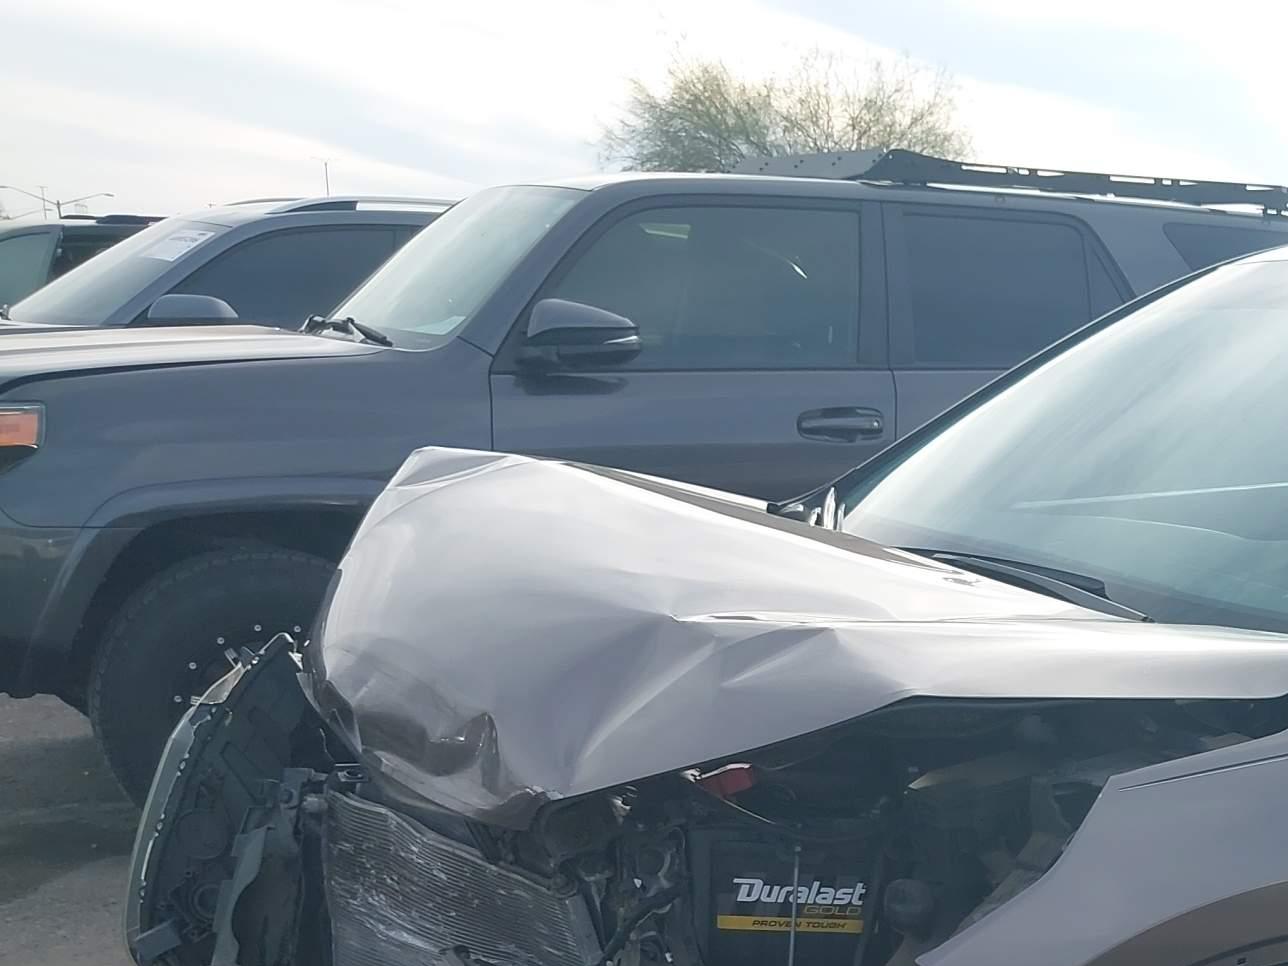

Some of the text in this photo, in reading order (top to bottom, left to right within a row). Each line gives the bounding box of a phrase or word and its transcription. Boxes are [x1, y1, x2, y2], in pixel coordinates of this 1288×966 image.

[732, 877, 867, 906] Duralast
[803, 906, 862, 916] GOLD
[752, 920, 848, 929] PROVEN TOUGH
